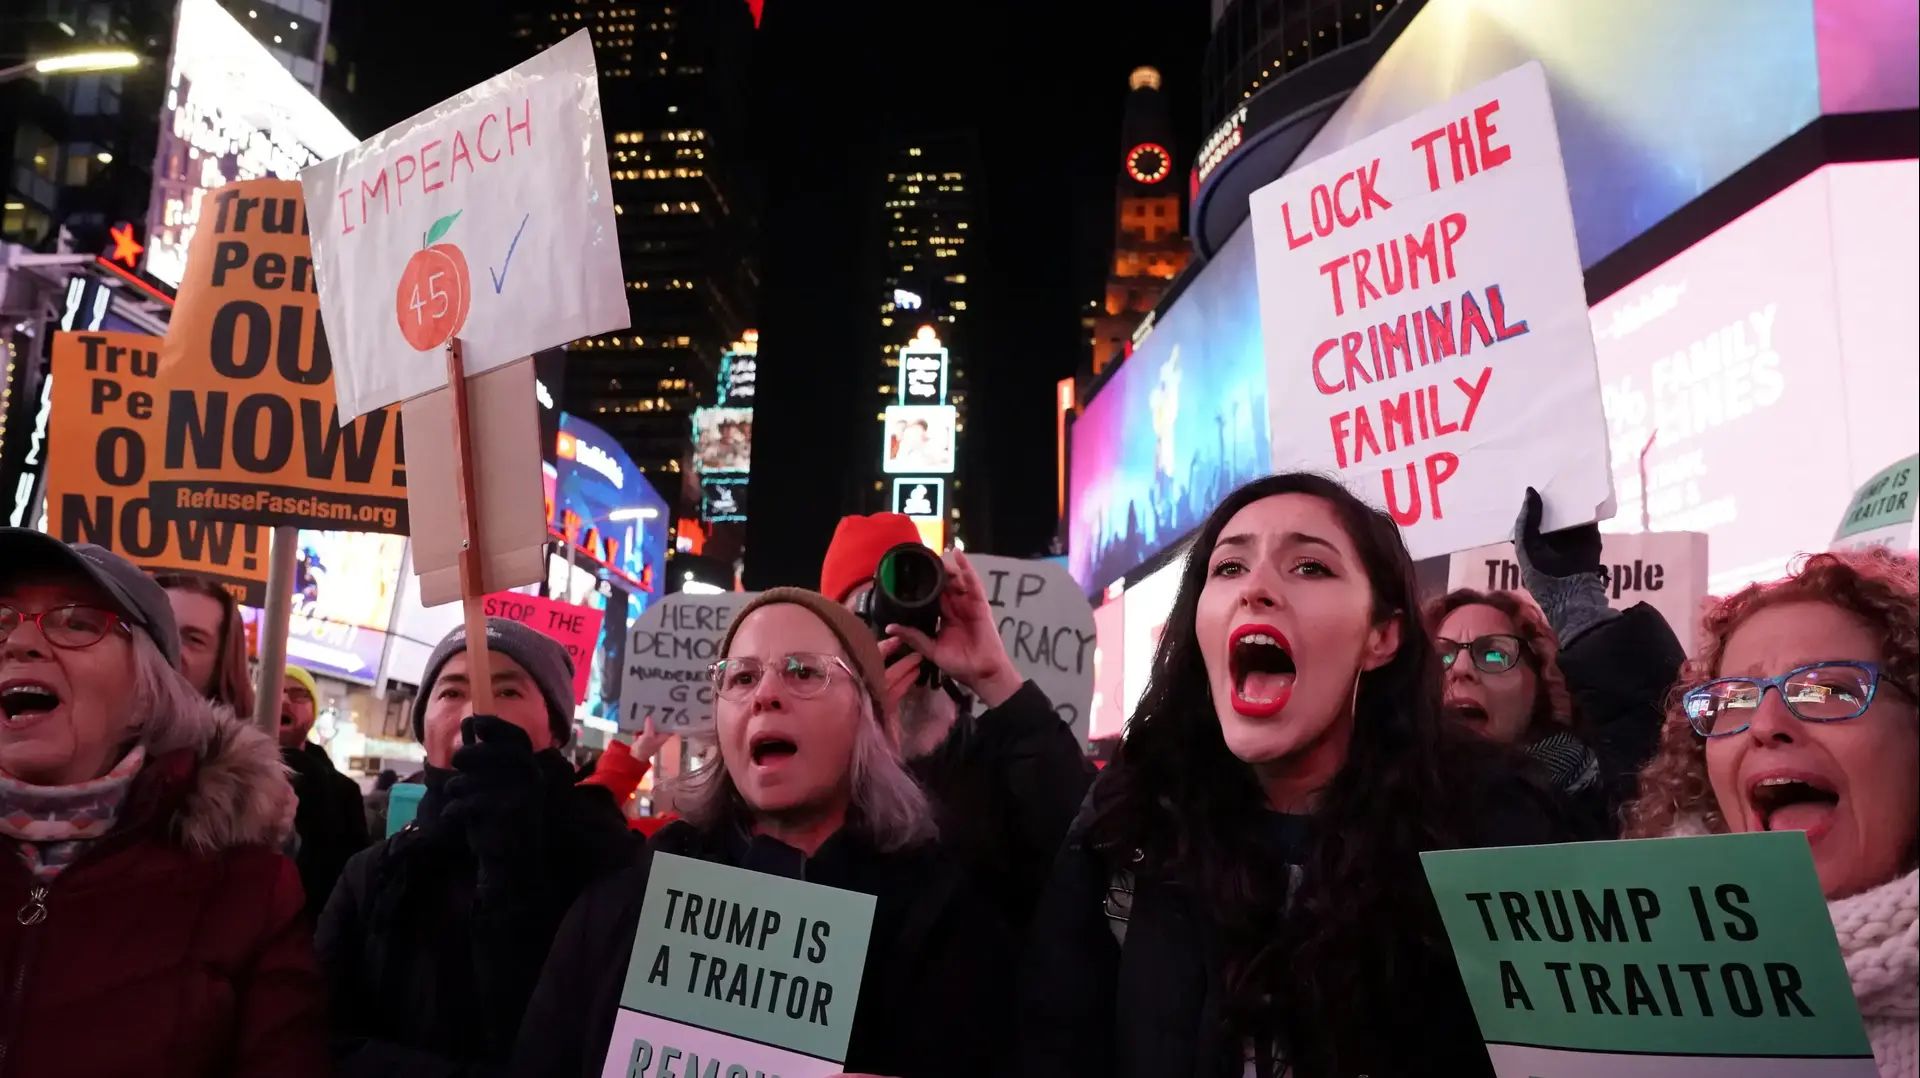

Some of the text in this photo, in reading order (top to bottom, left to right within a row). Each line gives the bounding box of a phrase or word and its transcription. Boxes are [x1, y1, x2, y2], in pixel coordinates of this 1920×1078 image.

[338, 98, 532, 236] IMPEACH
[1280, 99, 1512, 251] LOCK THE
[213, 189, 309, 236] Tru
[408, 272, 449, 326] 45
[1320, 212, 1467, 316] TRUMP
[1312, 287, 1530, 396] CRIMINAL
[1651, 302, 1778, 400] FAMILY
[164, 390, 407, 487] NOW!
[1329, 364, 1494, 469] FAMILY
[176, 487, 397, 528] RefuseFascism.org
[1381, 452, 1461, 528] UP
[1892, 468, 1911, 489] IS
[61, 493, 258, 571] NOW!
[1485, 559, 1526, 591] Th
[484, 598, 586, 634] STOP THE
[660, 603, 731, 632] HERE
[629, 701, 691, 727] 1776
[664, 888, 831, 964] TRUMP IS
[1465, 883, 1760, 943] TRUMP IS
[647, 944, 834, 1027] A TRAITOR
[1500, 960, 1815, 1018] A TRAITOR
